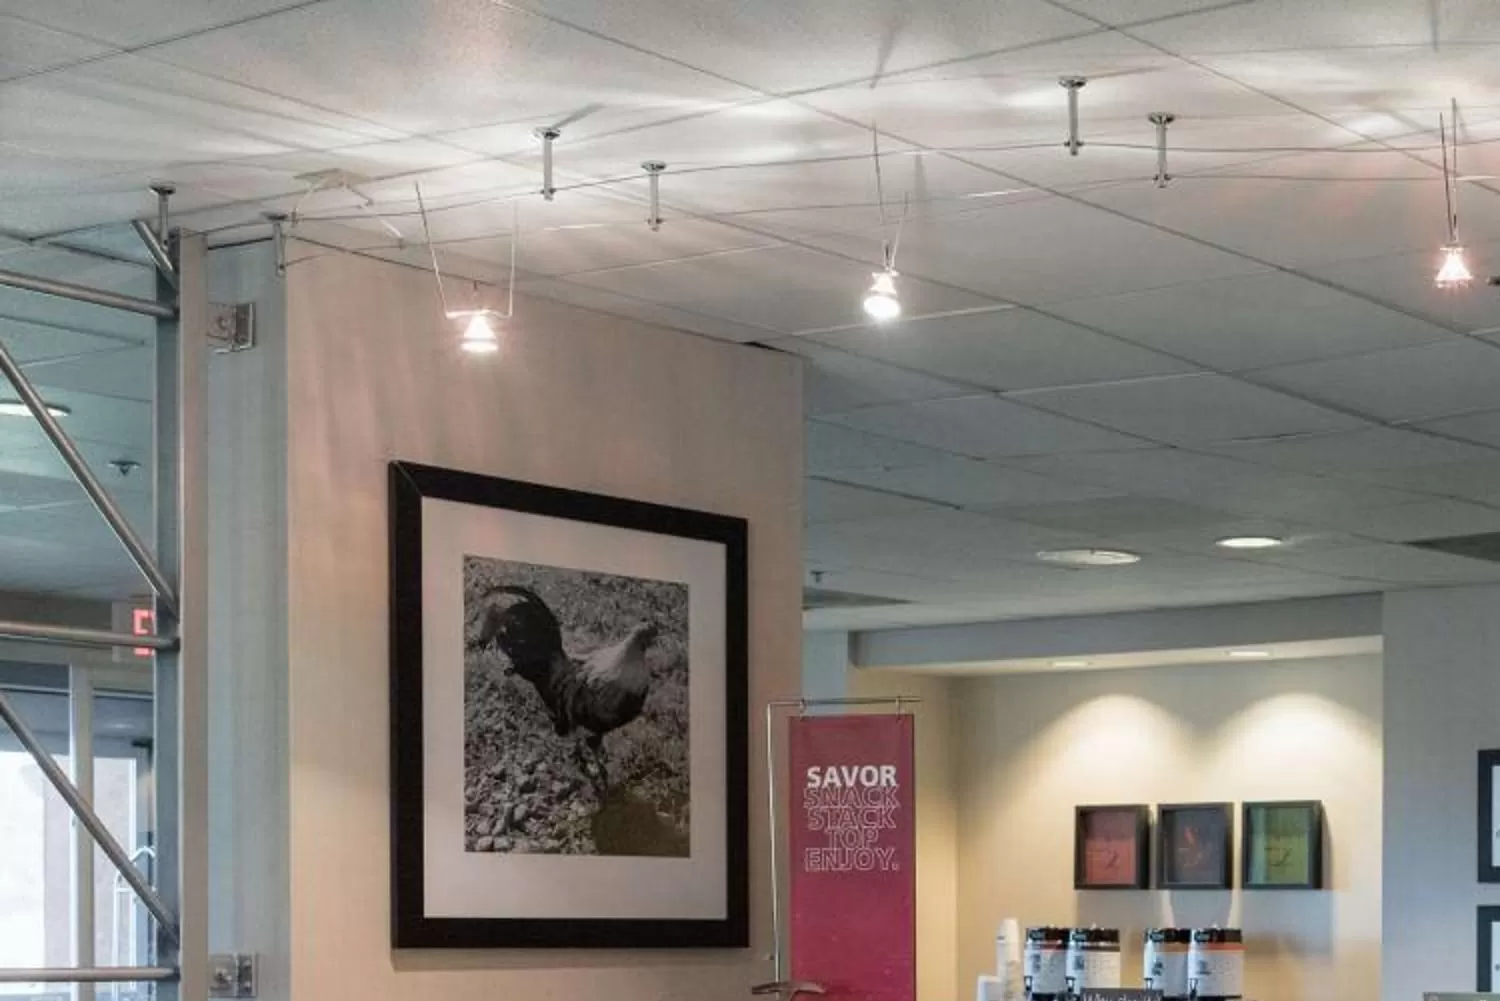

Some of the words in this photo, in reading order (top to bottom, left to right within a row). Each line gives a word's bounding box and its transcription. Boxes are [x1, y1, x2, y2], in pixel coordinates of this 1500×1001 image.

[807, 765, 897, 788] SAVOR
[803, 785, 901, 808] SNACK
[807, 806, 897, 830] STACK
[824, 827, 880, 849] TOP
[804, 847, 901, 872] ENJOY.
